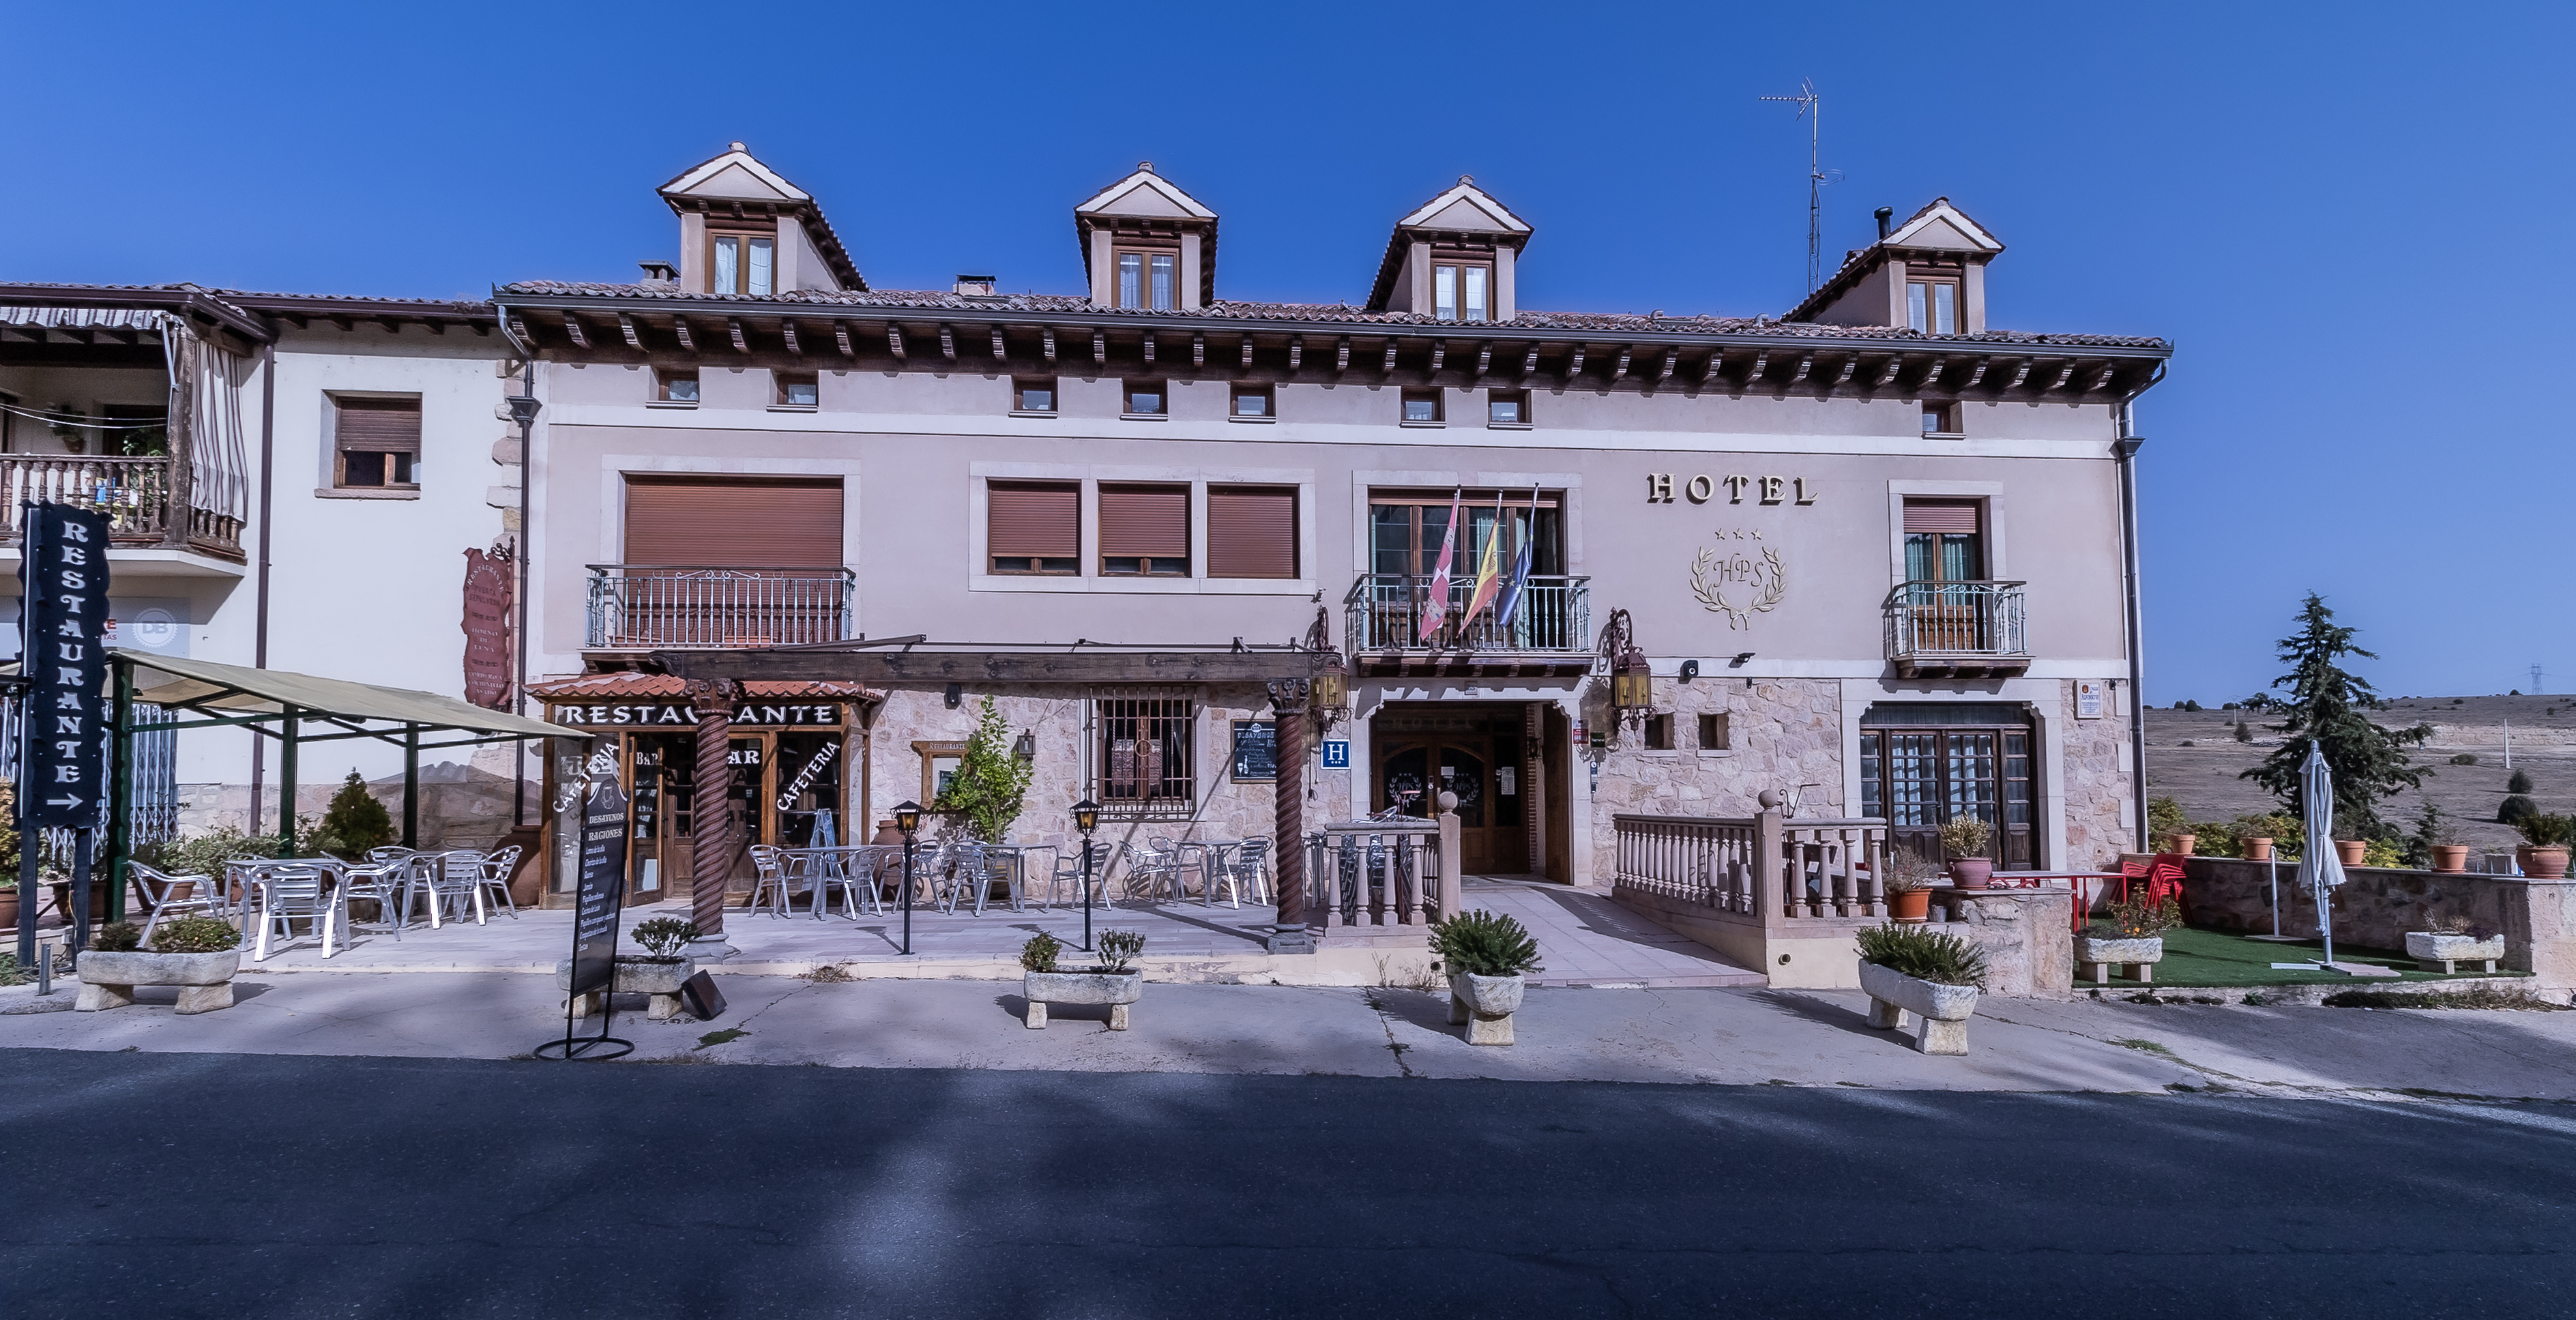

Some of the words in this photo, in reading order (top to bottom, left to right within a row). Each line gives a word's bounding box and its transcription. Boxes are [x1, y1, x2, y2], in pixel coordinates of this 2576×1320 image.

[1649, 473, 1819, 503] HOTEL
[467, 564, 505, 592] RESTAURANTE
[1712, 552, 1764, 588] HPS
[471, 627, 499, 636] HORNO
[56, 520, 89, 782] RESTAURANTE
[929, 742, 966, 750] RESTAURANTE
[1328, 744, 1345, 761] H
[636, 751, 658, 765] BAR
[727, 750, 760, 765] AR
[553, 742, 619, 813] CAFETERIA
[776, 741, 840, 811] CAFETERIA
[589, 812, 624, 824] DESAYUNOS
[588, 827, 624, 841] RACIONES
